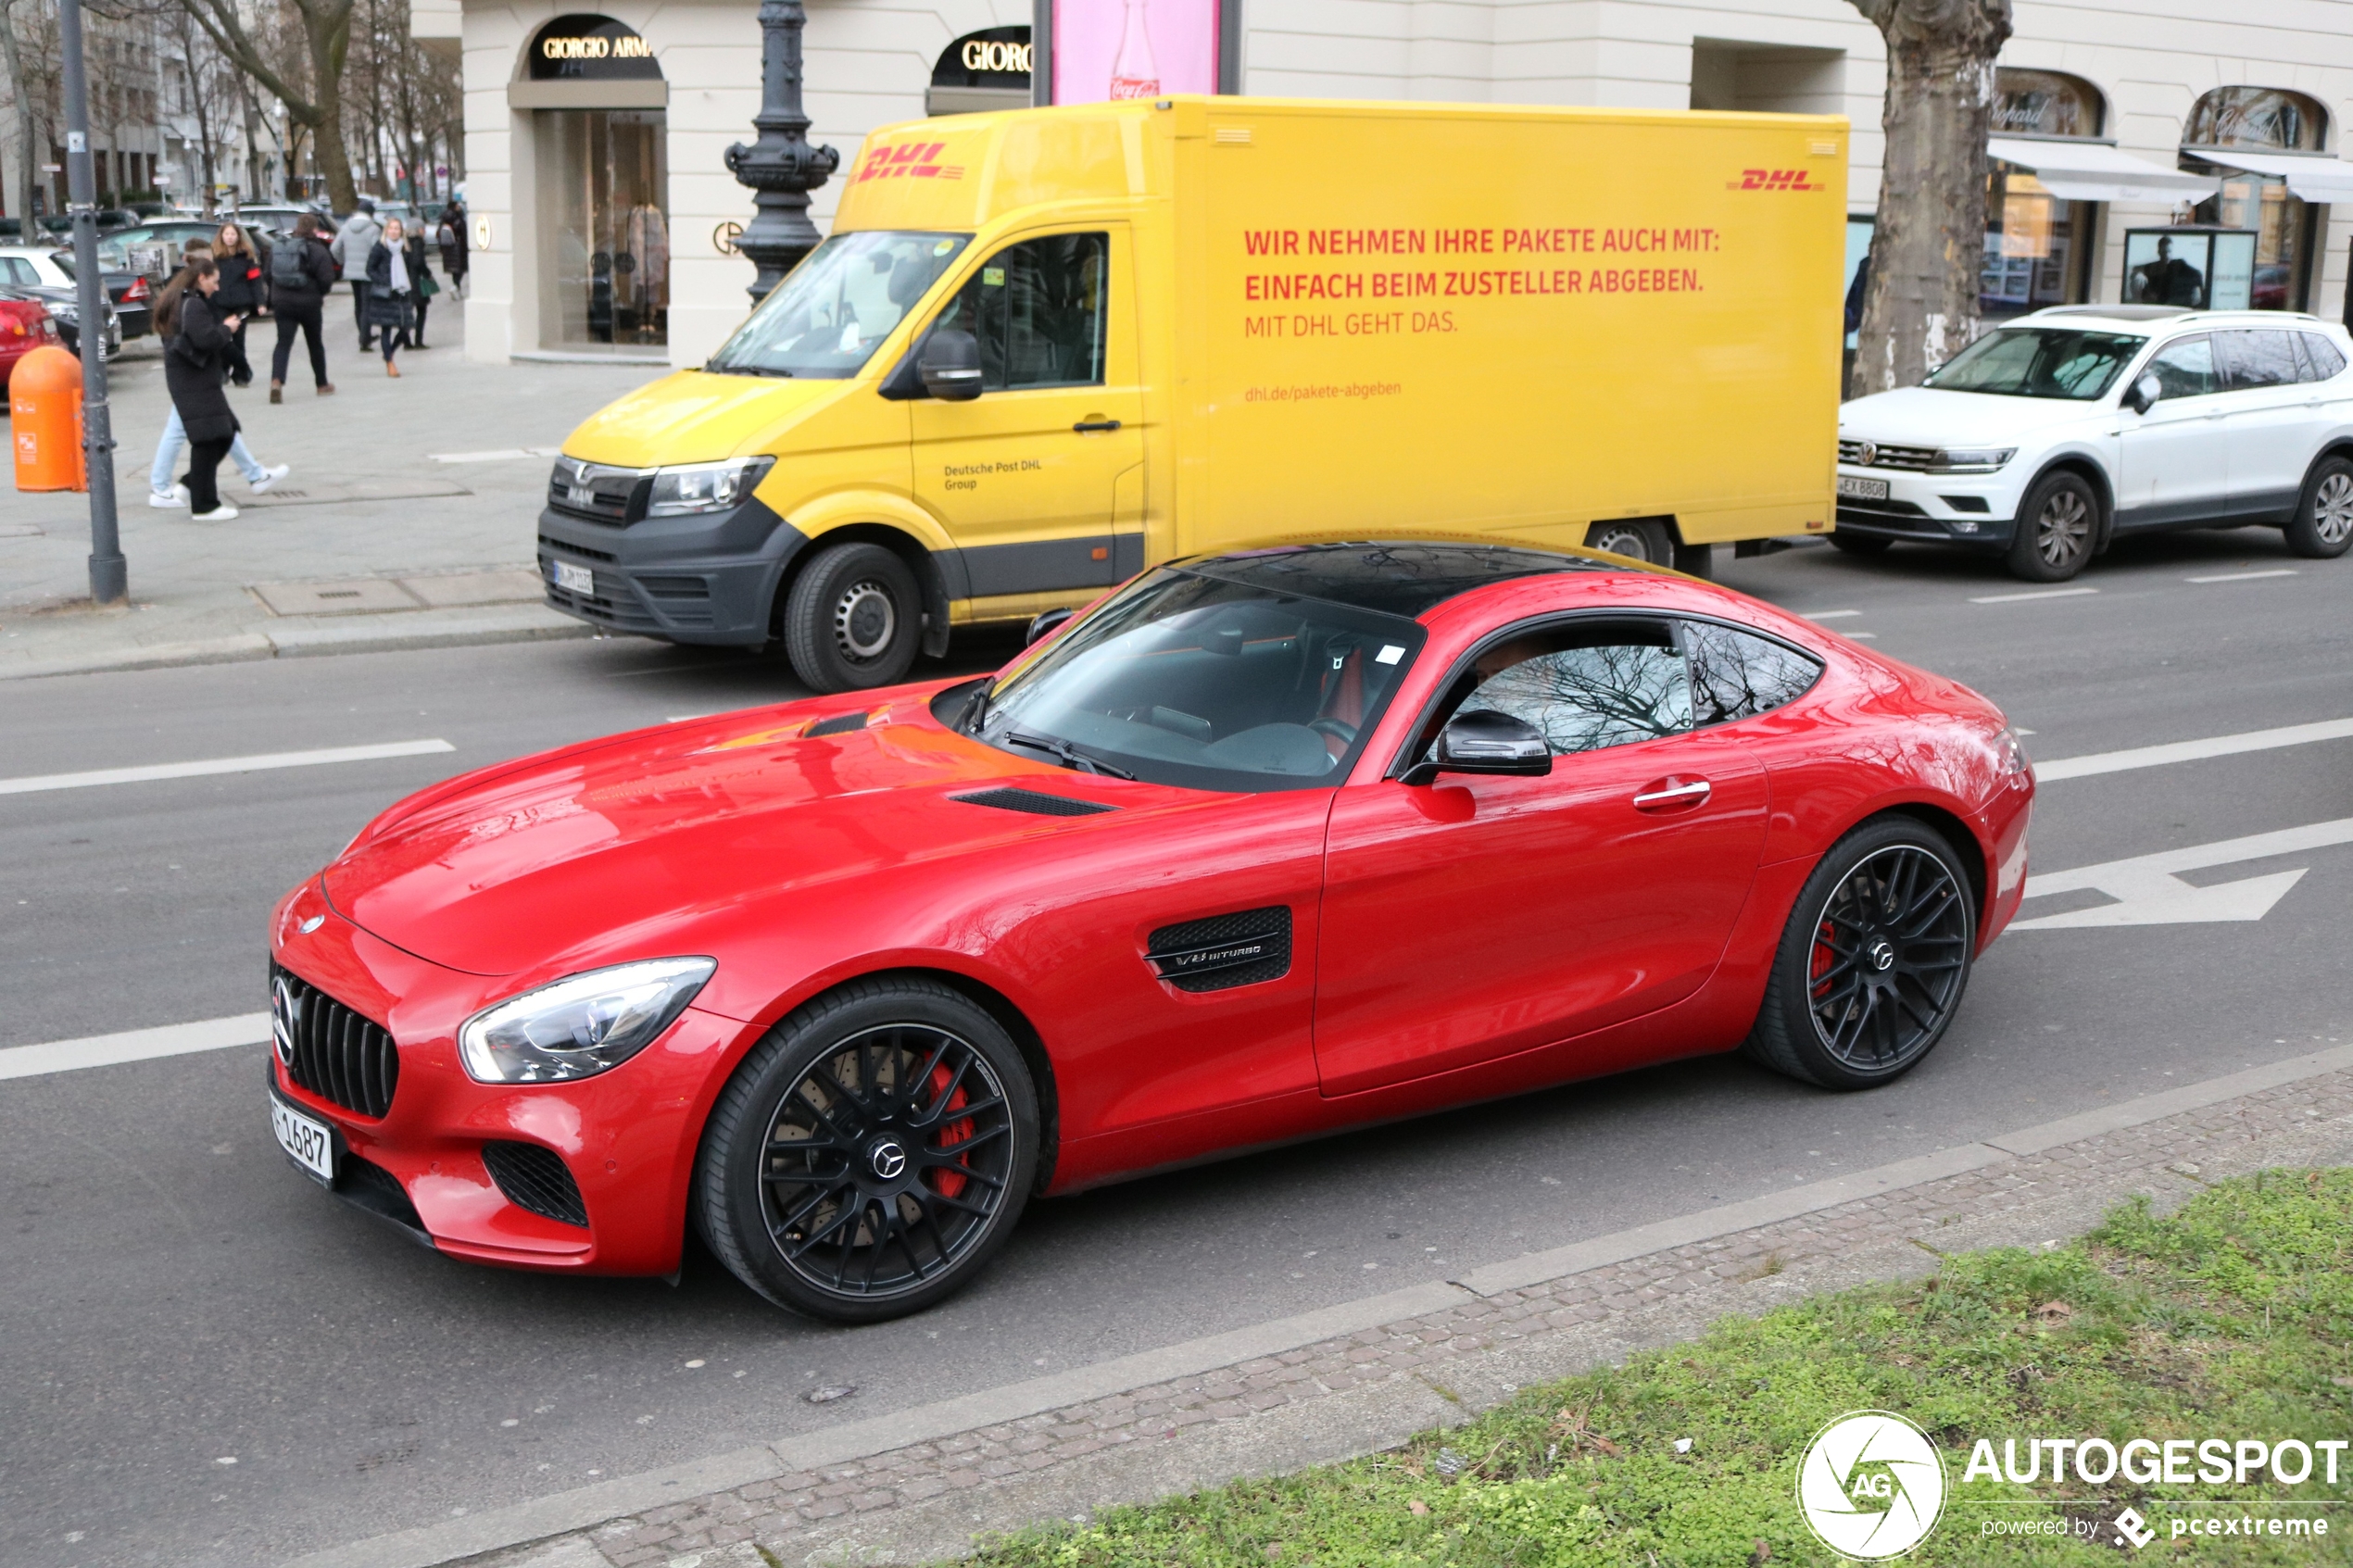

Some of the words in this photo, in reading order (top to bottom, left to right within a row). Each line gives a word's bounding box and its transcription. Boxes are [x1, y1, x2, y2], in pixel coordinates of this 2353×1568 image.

[543, 37, 610, 58] GIORGIO
[858, 143, 947, 182] DHL
[1740, 169, 1812, 191] DHL
[1245, 230, 1300, 256] WIR
[1308, 229, 1426, 255] NEHMEN
[1435, 229, 1494, 254] IHRE
[1503, 229, 1595, 254] PAKETE
[1602, 229, 1667, 253] AUCH
[1673, 229, 1720, 252] MIT:
[1246, 273, 1364, 301] EINFACH
[1372, 272, 1437, 298] BEIM
[1444, 270, 1582, 296] ZUSTELLER
[1589, 269, 1705, 294] ABGEBEN.
[1245, 316, 1287, 339] MIT
[1294, 315, 1340, 337] DHL
[1345, 312, 1404, 335] GEHT
[1413, 310, 1458, 333] DAS.
[1245, 381, 1402, 403] dhl.de/pakete-abgeben
[944, 463, 994, 477] Deutsche
[996, 461, 1018, 473] Post
[1021, 460, 1042, 471] DHL
[568, 486, 595, 505] MAN
[944, 480, 977, 492] Group
[1859, 481, 1885, 497] 8808
[1176, 952, 1206, 966] V8
[1209, 946, 1261, 960] BITURBO
[283, 1111, 325, 1169] 1687
